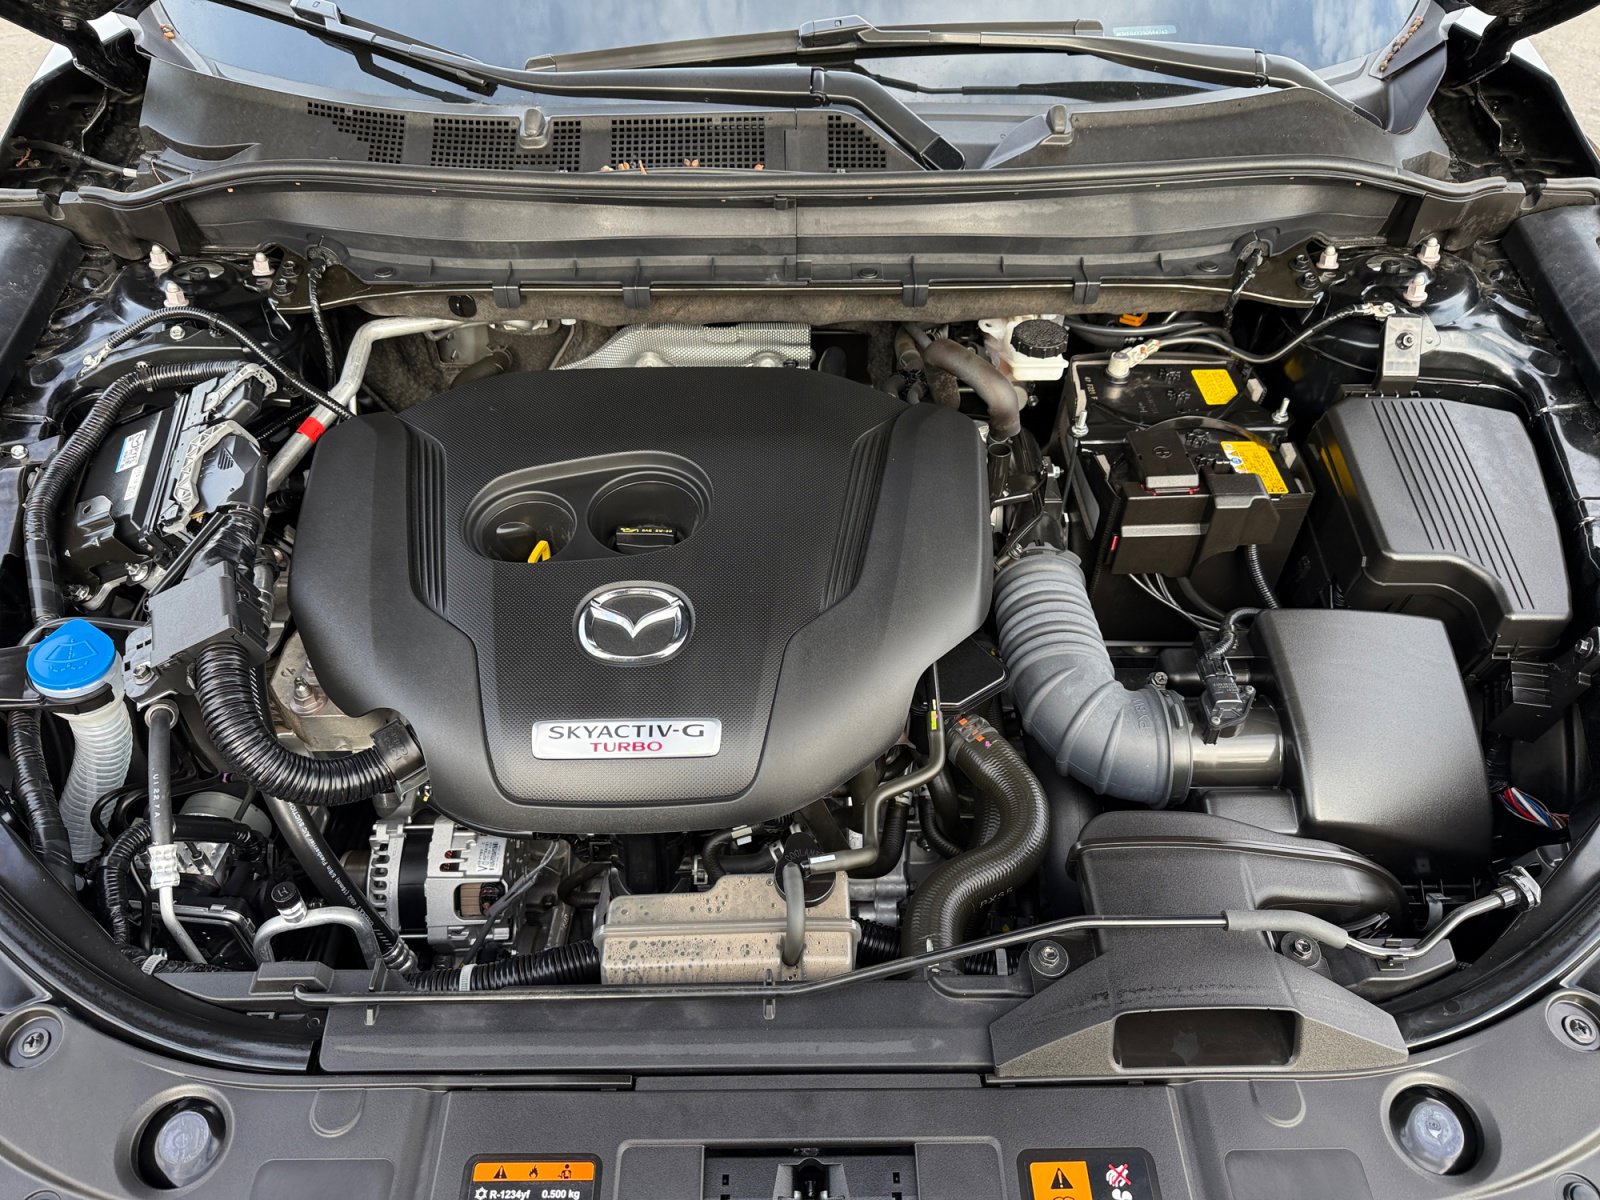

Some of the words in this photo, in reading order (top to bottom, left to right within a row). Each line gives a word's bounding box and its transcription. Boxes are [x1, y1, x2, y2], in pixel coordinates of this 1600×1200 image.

[548, 724, 705, 740] SKYACTIV-G
[590, 741, 663, 752] TURBO
[287, 801, 305, 827] SUCTION
[489, 1189, 531, 1200] R-1234yf
[541, 1190, 567, 1199] 0.500
[568, 1190, 581, 1200] kg
